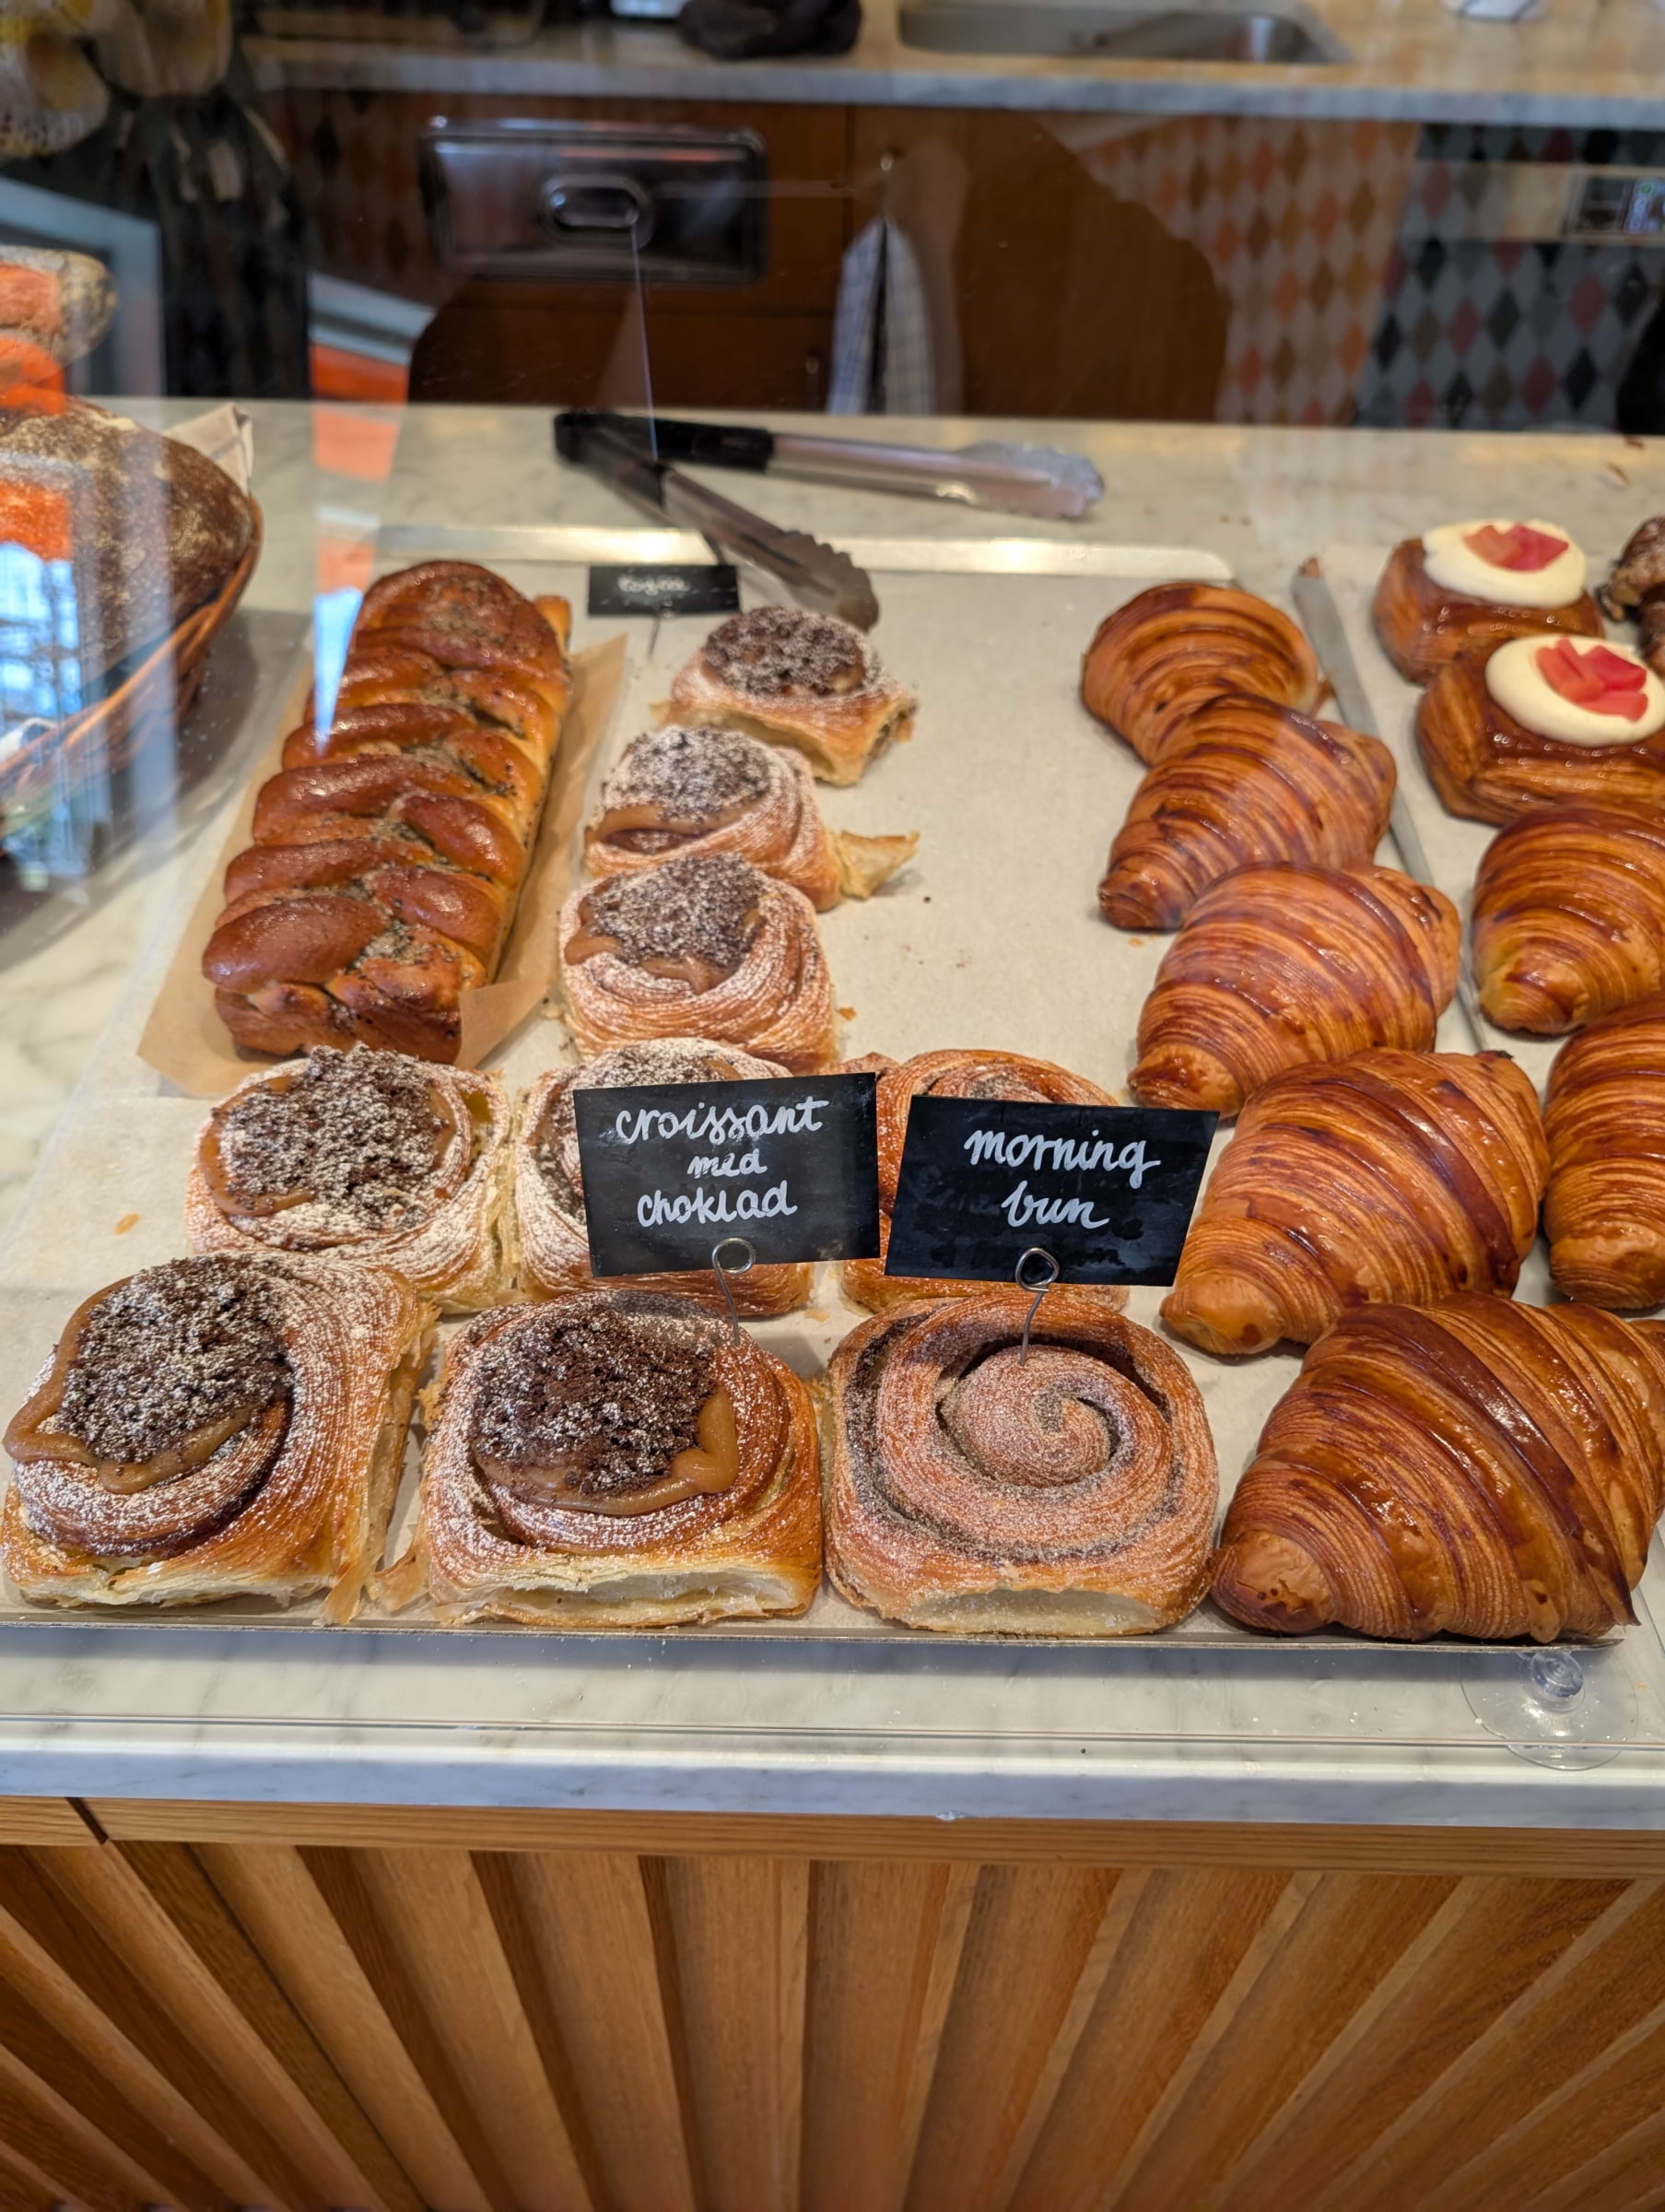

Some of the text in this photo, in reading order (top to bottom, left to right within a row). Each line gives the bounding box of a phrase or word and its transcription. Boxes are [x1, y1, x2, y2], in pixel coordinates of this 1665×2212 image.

[616, 1097, 829, 1146] croissant
[687, 1148, 768, 1179] med
[964, 1130, 1161, 1189] morning
[638, 1181, 798, 1228] choklad
[1002, 1181, 1109, 1229] bun
